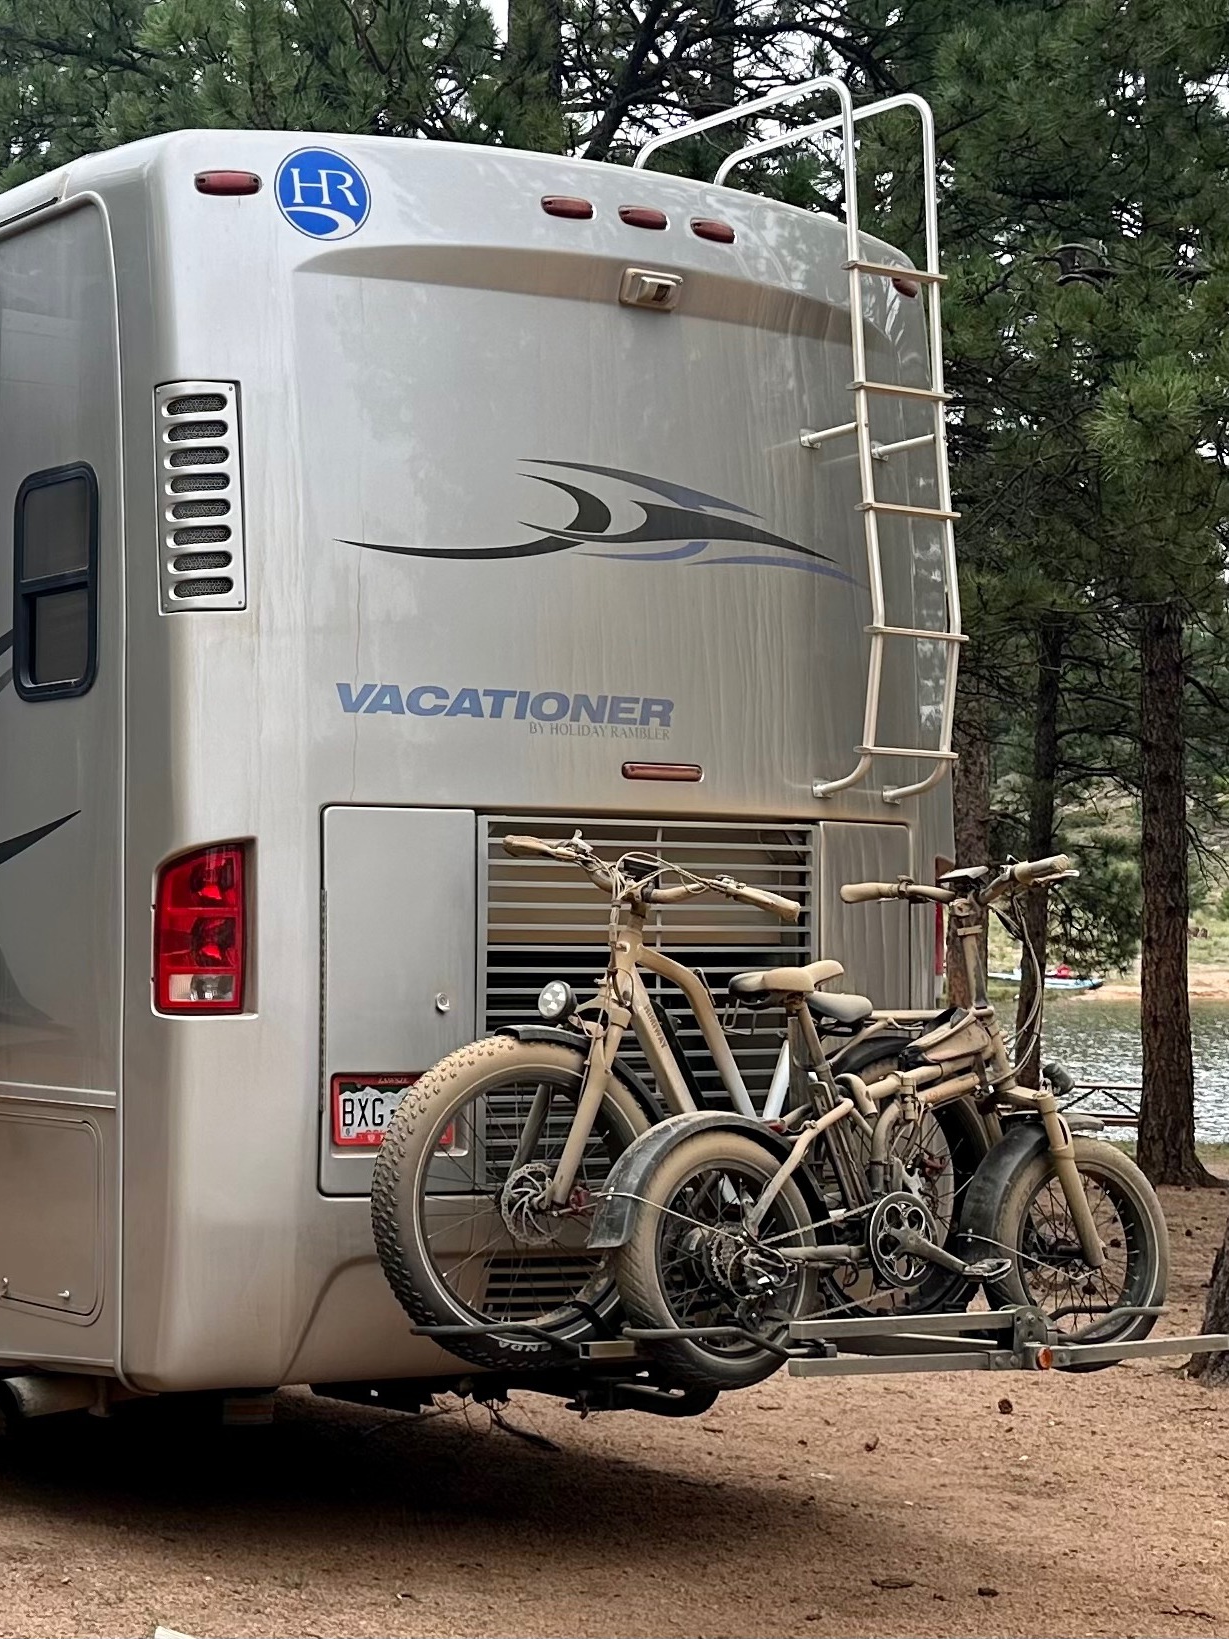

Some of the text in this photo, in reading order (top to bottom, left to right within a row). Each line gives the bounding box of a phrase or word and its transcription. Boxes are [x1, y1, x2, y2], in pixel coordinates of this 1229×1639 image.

[290, 167, 360, 207] HR
[335, 682, 675, 728] VACATIONER
[529, 720, 671, 741] BY HOLIDAY RAMBLER
[498, 1340, 553, 1353] ENDA
